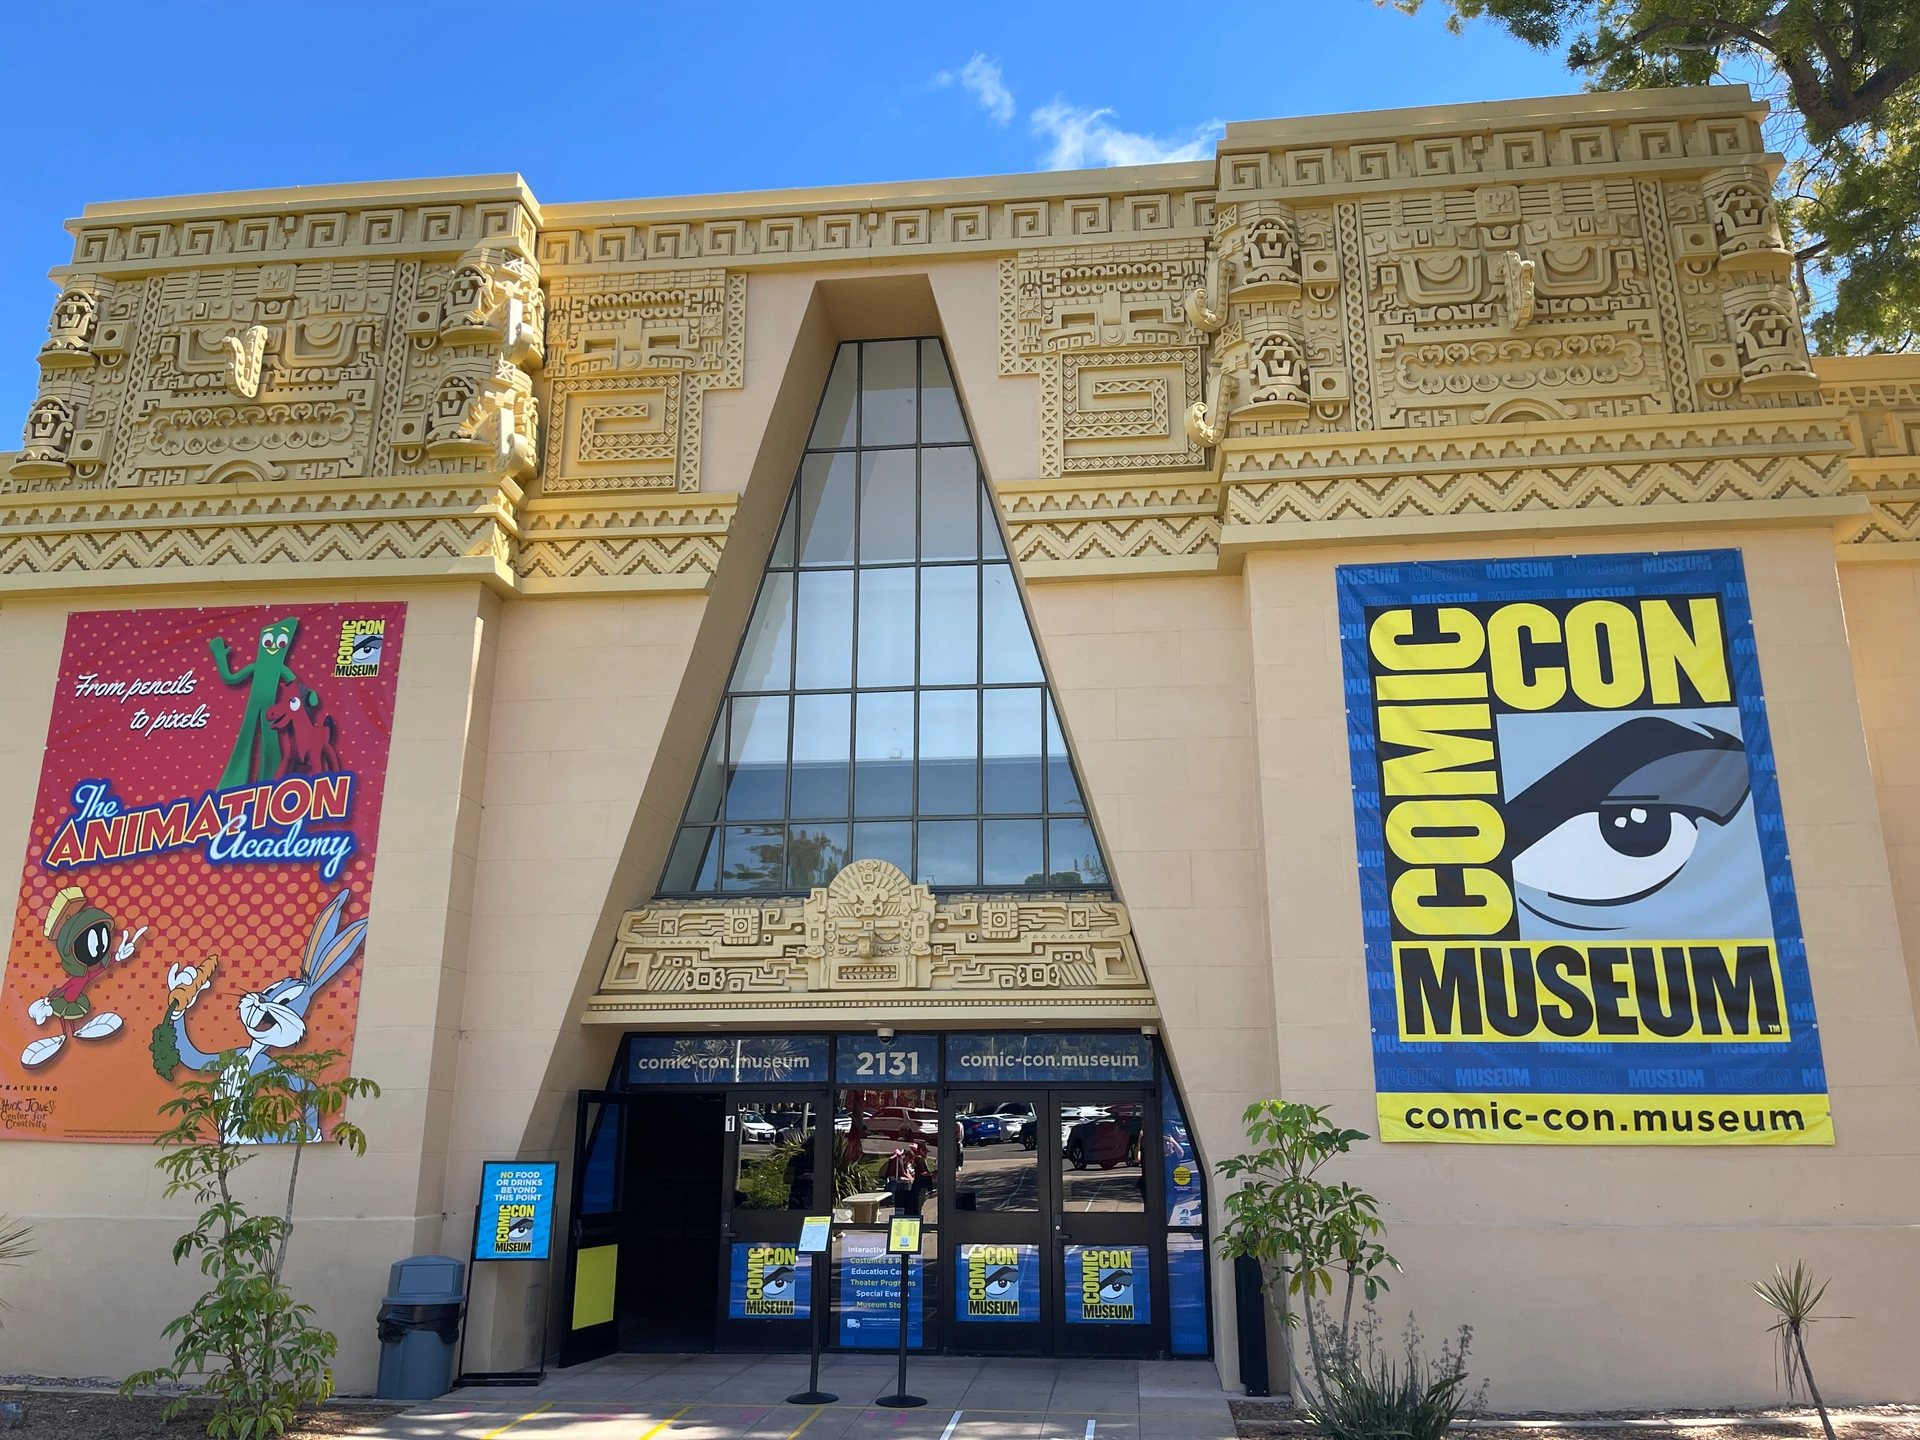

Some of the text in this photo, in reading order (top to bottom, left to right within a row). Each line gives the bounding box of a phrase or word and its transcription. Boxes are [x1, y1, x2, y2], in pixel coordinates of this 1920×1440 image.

[1409, 565, 1477, 583] MUSEUM
[1486, 562, 1554, 579] MUSEUM
[1563, 559, 1633, 576] MUSEUM
[1642, 556, 1712, 574] MUSEUM
[355, 620, 385, 635] CON
[336, 620, 357, 665] COMIC
[1487, 598, 1732, 711] CON
[335, 664, 378, 678] MUSEUM
[75, 670, 198, 704] From pencils
[130, 703, 211, 738] to pixels
[1369, 607, 1514, 936] COMIC
[75, 784, 119, 823] The
[46, 776, 352, 868] ANIMATION
[210, 814, 352, 878] Academy
[1400, 946, 1783, 1036] MUSEUM
[1768, 1025, 1781, 1033] TM
[639, 1056, 810, 1070] comic-con.museum
[857, 1051, 919, 1076] 2131
[960, 1051, 1139, 1067] comic-con.museum
[1455, 1068, 1531, 1087] MUSEUM
[1540, 1068, 1616, 1087] MUSEUM
[1628, 1069, 1705, 1088] MUSEUM
[1715, 1069, 1792, 1088] MUSEUM
[1, 1111, 47, 1121] Center for
[727, 1116, 734, 1131] 1
[1405, 1101, 1805, 1132] comic-con.museum
[6, 1120, 47, 1131] Creativity
[516, 1194, 542, 1202] POINT
[511, 1205, 535, 1217] CON
[496, 1205, 511, 1242] COMIC
[495, 1242, 531, 1252] MUSEUM
[985, 1247, 1018, 1265] CON
[764, 1248, 796, 1265] CON
[1099, 1250, 1132, 1268] CON
[746, 1248, 764, 1300] COMIC
[968, 1245, 986, 1300] COMIC
[1082, 1250, 1100, 1304] COMIC
[856, 1290, 883, 1298] Special
[746, 1300, 794, 1314] MUSEUM
[969, 1301, 1018, 1314] MUSEUM
[1084, 1304, 1133, 1318] MUSEUM
